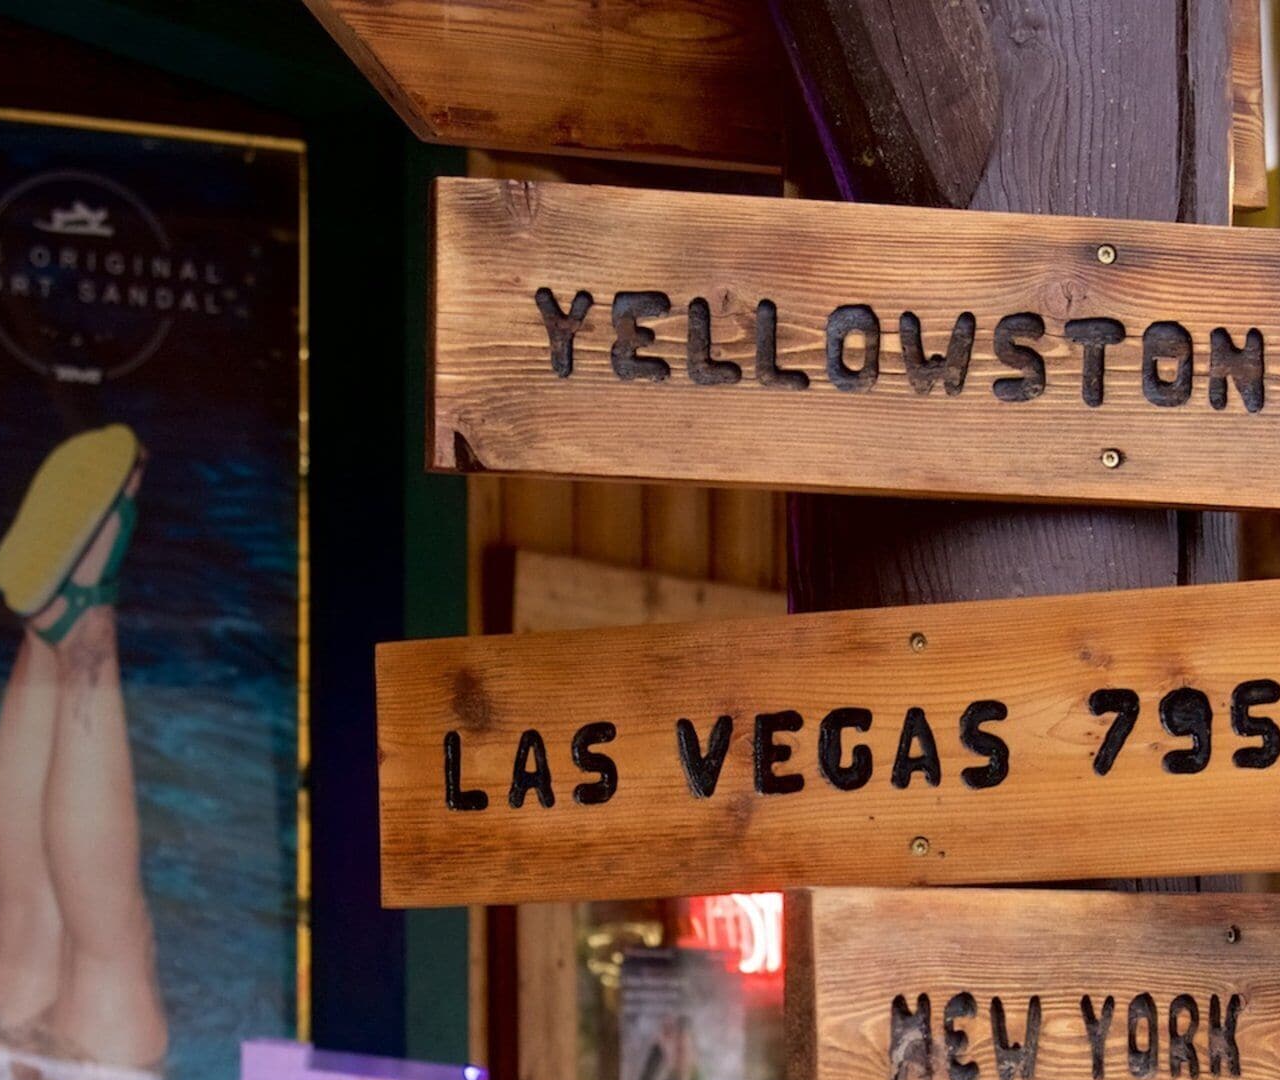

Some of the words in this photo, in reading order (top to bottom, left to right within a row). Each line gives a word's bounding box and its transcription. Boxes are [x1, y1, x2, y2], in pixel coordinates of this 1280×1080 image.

[29, 246, 220, 285] ORIGINAL
[78, 280, 220, 314] SANDAL
[442, 721, 617, 811] LAS
[676, 699, 1010, 800] VEGAS
[1080, 991, 1242, 1080] YORK
